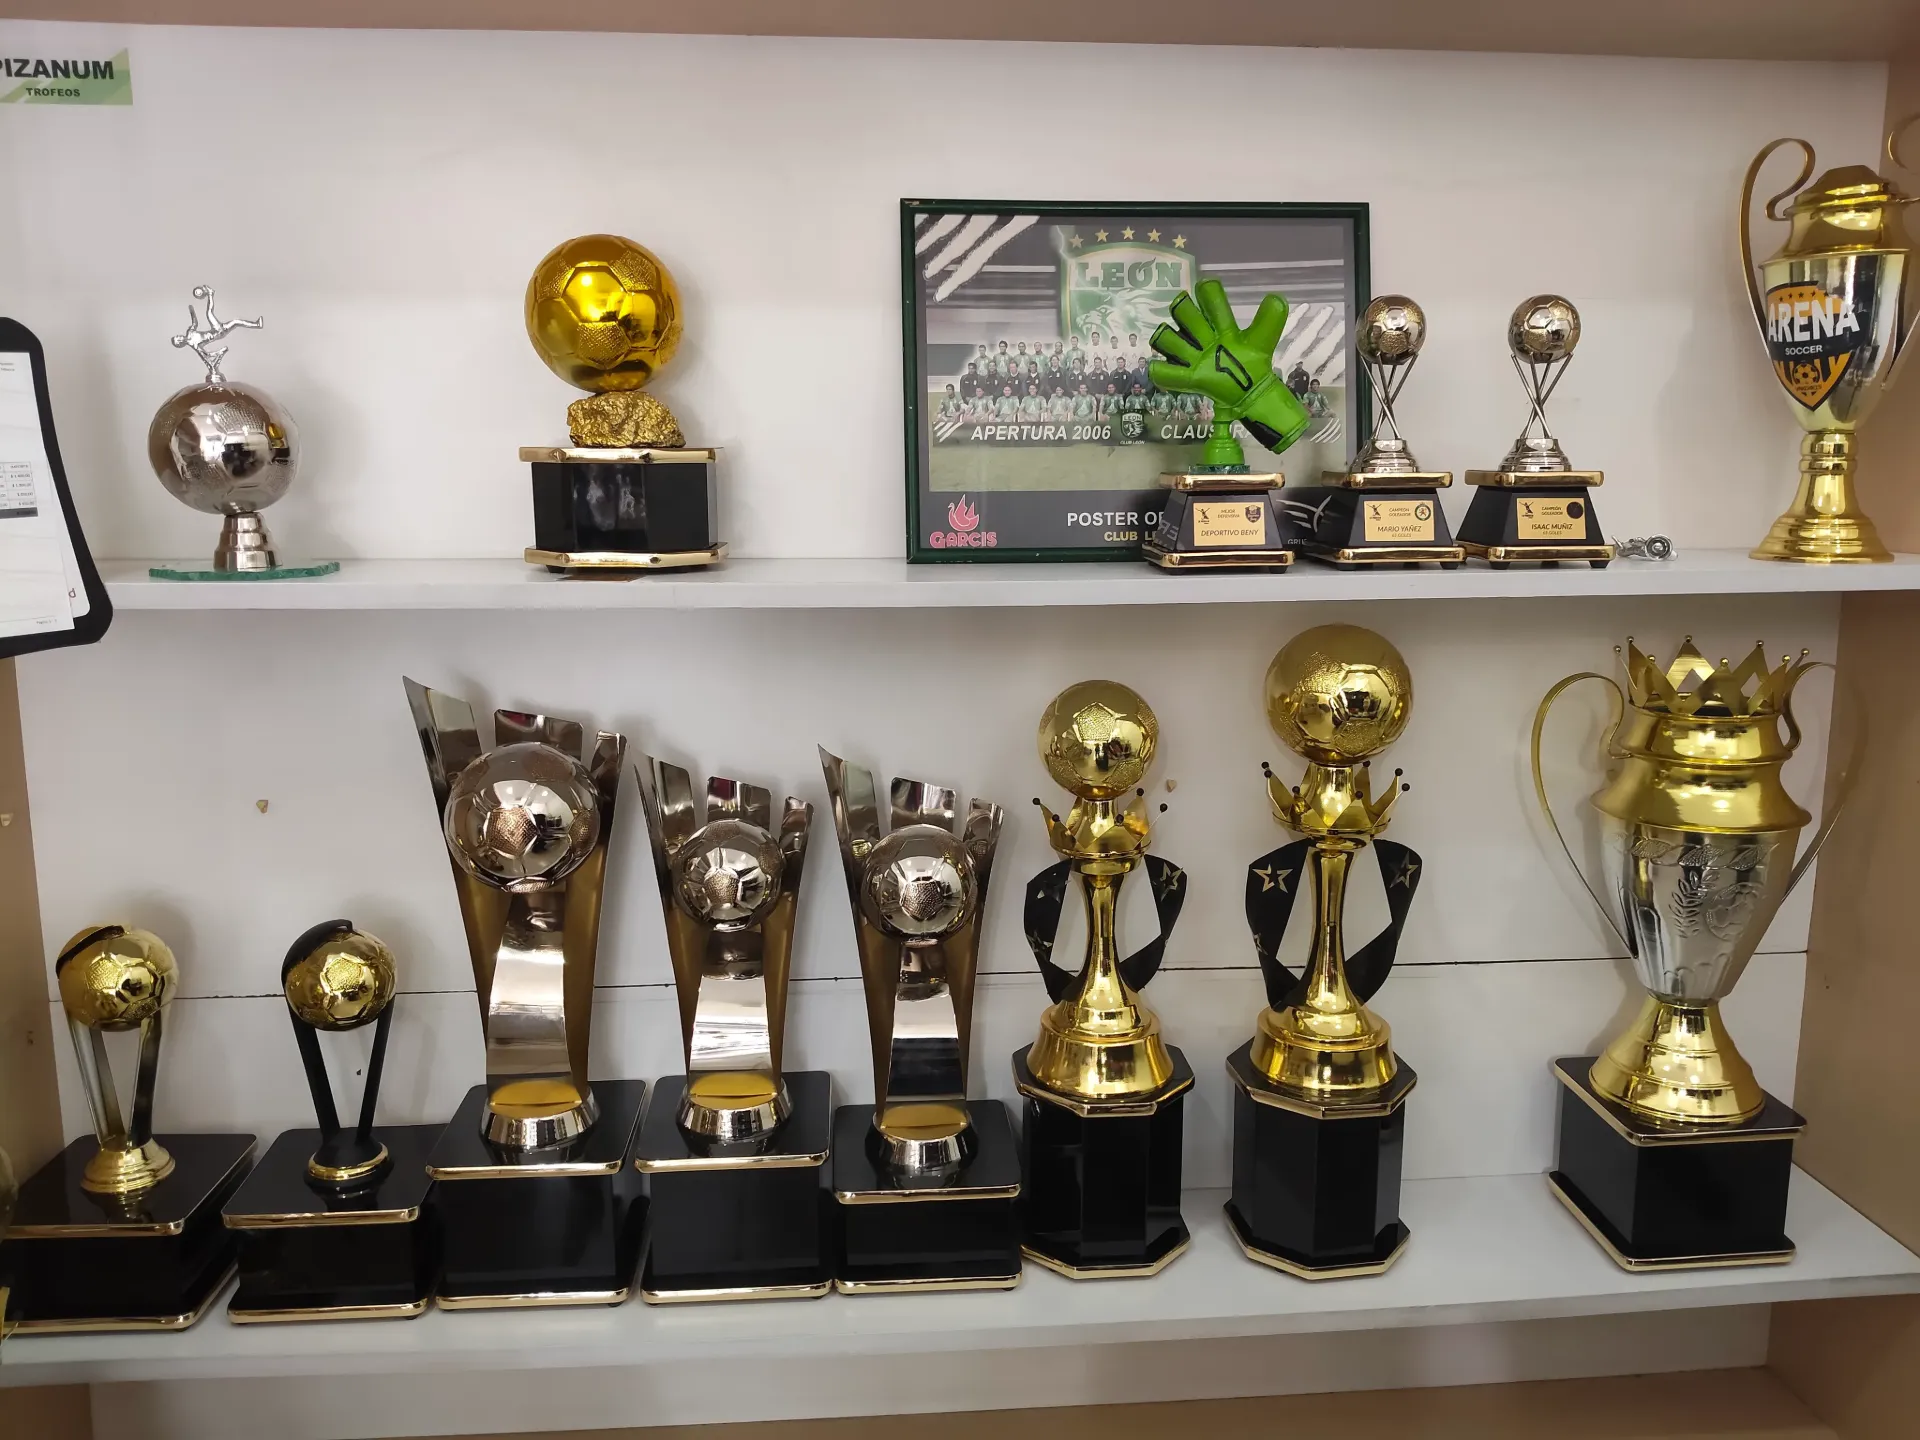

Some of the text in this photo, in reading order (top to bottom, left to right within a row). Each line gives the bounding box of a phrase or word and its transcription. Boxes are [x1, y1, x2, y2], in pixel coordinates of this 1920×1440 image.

[0, 58, 114, 80] IZANUM
[26, 87, 81, 97] TROFEOS
[1768, 297, 1860, 343] ARENA
[1785, 344, 1823, 356] SOCCER
[970, 425, 1112, 441] APERTURA 2006
[1067, 512, 1139, 527] POSTER
[929, 531, 998, 549] GARCIS
[1104, 531, 1138, 541] CLUB
